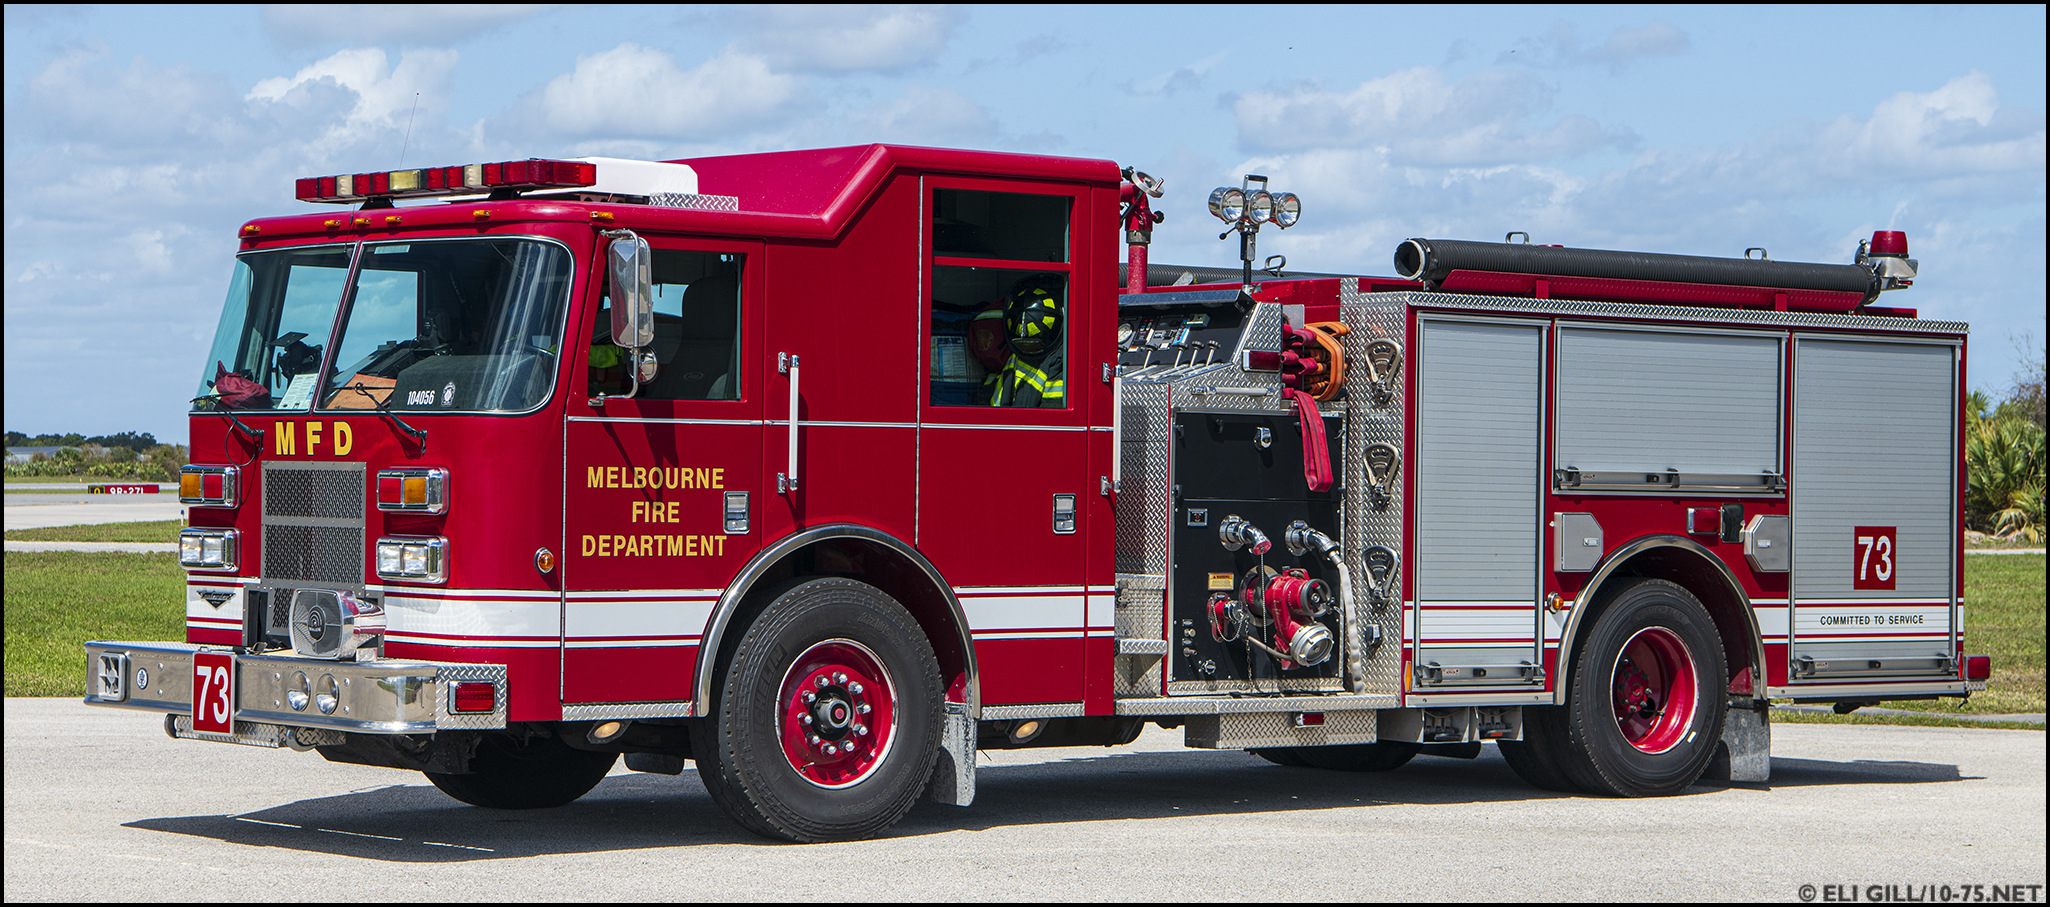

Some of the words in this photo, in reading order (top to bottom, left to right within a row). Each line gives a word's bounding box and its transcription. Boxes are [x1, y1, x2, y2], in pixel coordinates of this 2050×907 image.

[407, 390, 436, 406] 104056
[587, 466, 725, 489] MELBOURNE
[632, 501, 680, 523] FIRE
[582, 534, 728, 557] DEPARTMENT
[1858, 535, 1892, 581] 73
[1820, 616, 1871, 625] COMMITTED
[1873, 616, 1885, 625] TO
[1888, 615, 1924, 625] SERVICE
[196, 665, 230, 724] 73
